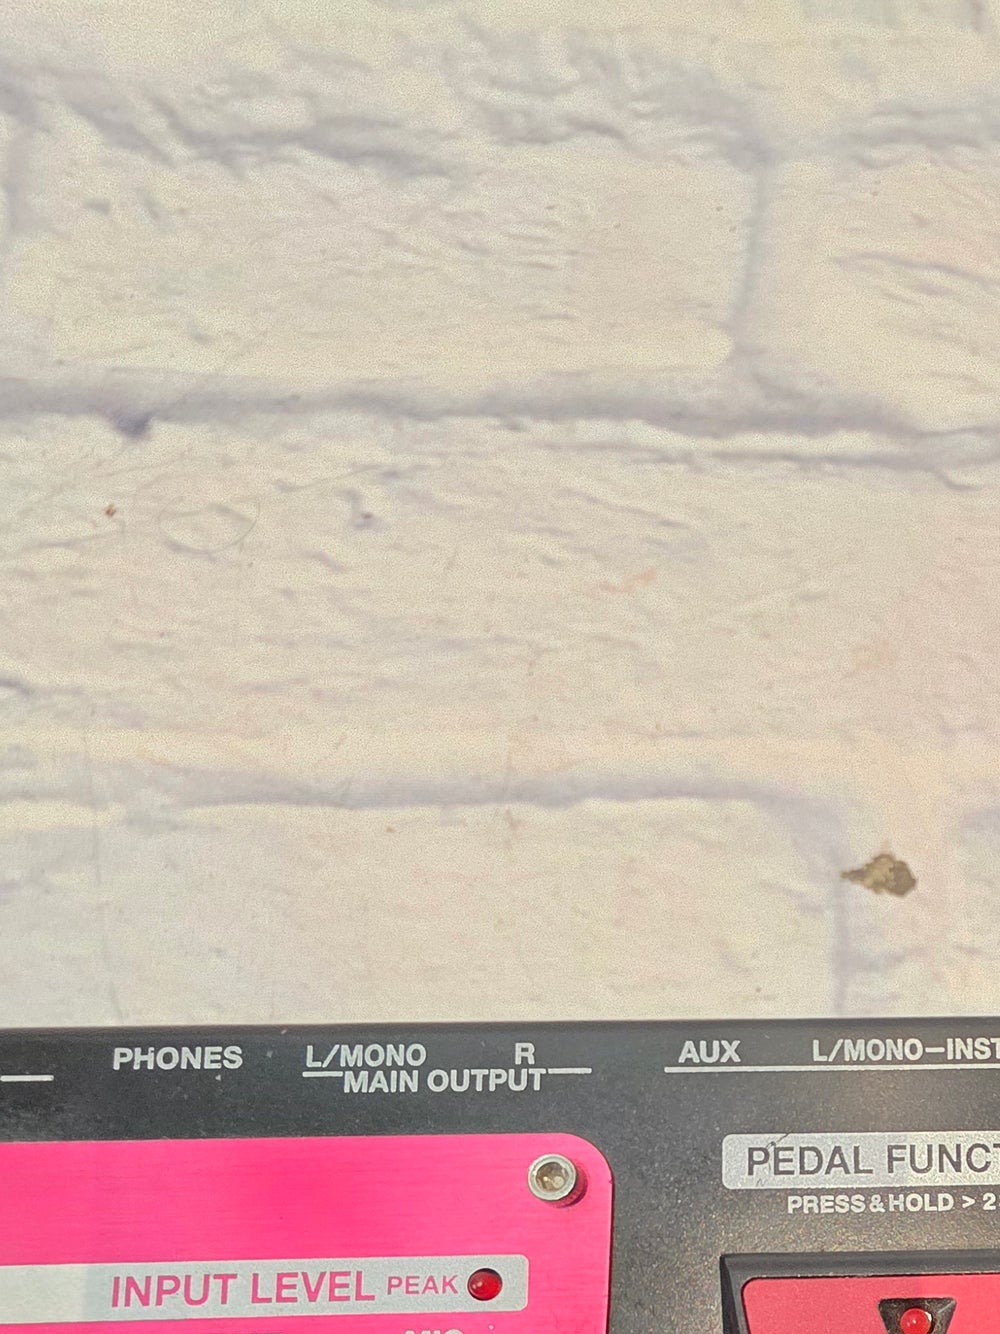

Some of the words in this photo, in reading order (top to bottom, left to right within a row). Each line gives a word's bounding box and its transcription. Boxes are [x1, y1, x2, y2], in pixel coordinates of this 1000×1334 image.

[112, 1046, 243, 1070] PHONES
[305, 1044, 427, 1068] L/MONO
[514, 1042, 535, 1065] R
[678, 1040, 742, 1064] AUX
[343, 1070, 419, 1094] MAIN
[427, 1067, 545, 1093] OUTPUT
[746, 1145, 873, 1176] PEDAL
[888, 1192, 954, 1212] HOLD
[110, 1274, 237, 1308] INPUT
[251, 1270, 375, 1303] LEVEL
[386, 1274, 458, 1296] PEAK
